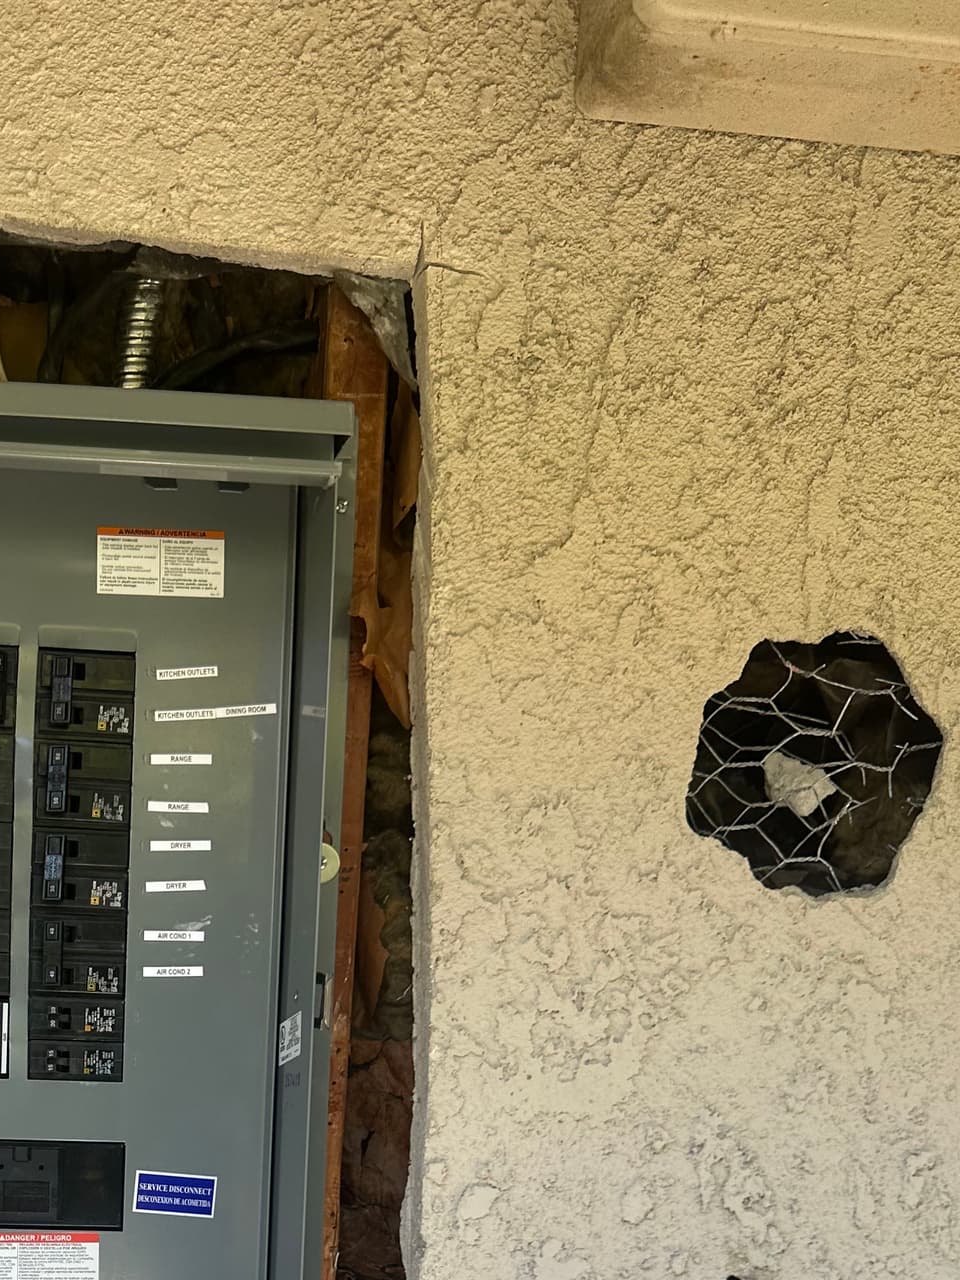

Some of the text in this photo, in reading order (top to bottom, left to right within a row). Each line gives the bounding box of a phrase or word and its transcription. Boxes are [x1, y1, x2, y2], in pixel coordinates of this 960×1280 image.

[159, 667, 215, 678] KITCHEN OUTLETS
[158, 710, 213, 719] KITCHEN OUTLETS
[225, 705, 267, 715] DINING ROOM
[167, 803, 190, 811] RANGE
[166, 882, 187, 890] DRYER
[157, 932, 168, 940] AIR
[169, 932, 187, 940] COND
[139, 1182, 212, 1196] SERVICE DISCONNECT
[137, 1194, 211, 1208] DESCONEXION DE ACOMETIDA
